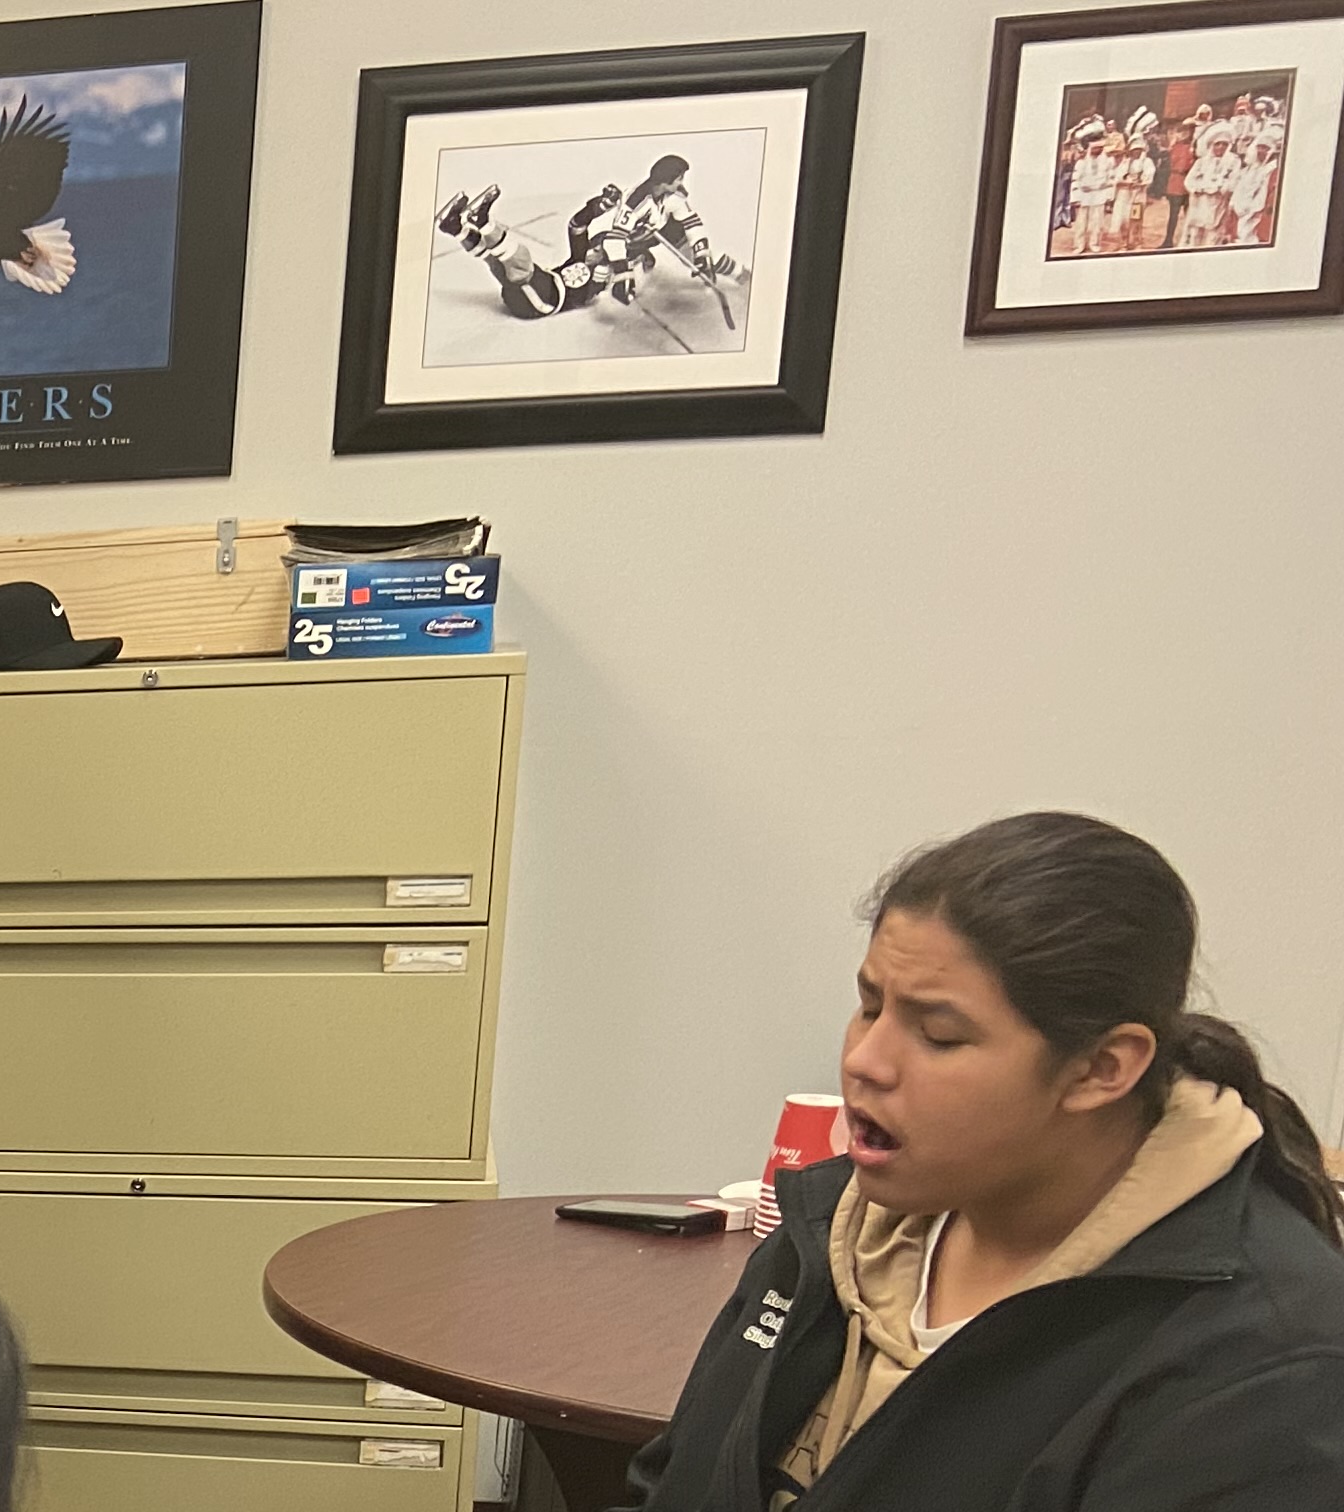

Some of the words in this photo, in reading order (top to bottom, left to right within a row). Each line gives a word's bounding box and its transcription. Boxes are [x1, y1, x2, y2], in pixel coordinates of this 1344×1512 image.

[444, 563, 486, 600] 25
[293, 619, 334, 655] 25
[426, 619, 477, 632] Continental
